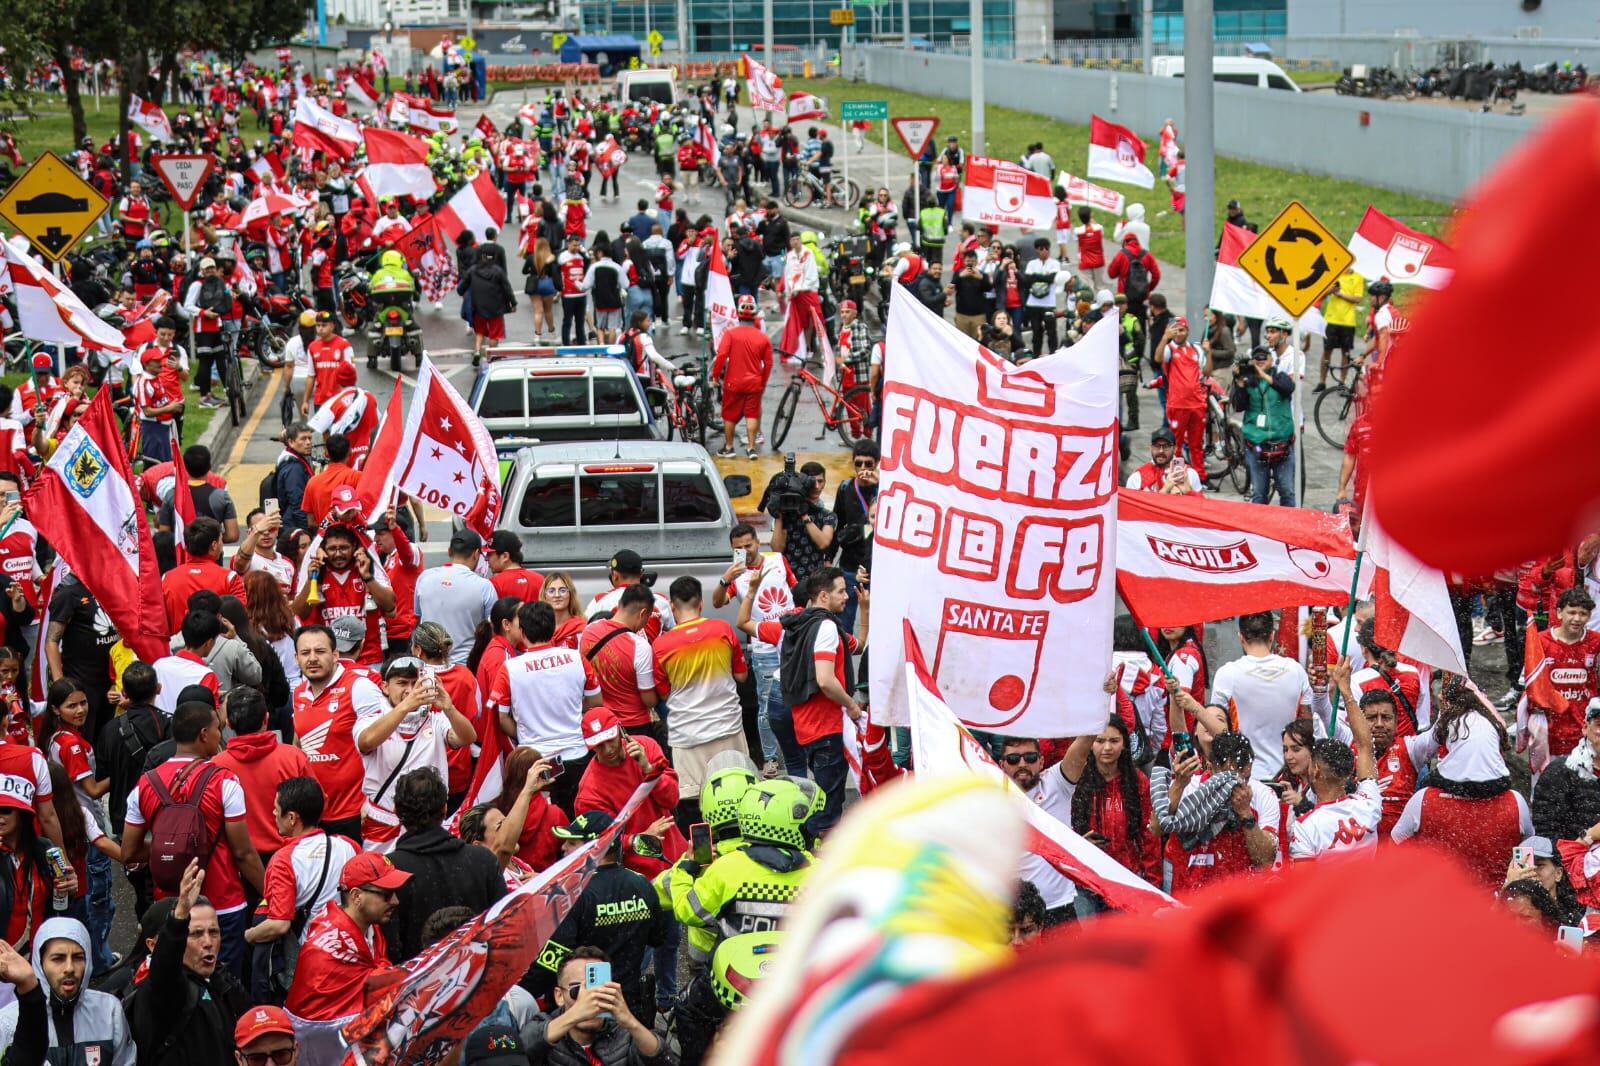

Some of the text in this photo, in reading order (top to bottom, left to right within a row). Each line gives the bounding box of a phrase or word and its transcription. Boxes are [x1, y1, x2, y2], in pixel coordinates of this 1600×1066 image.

[175, 161, 192, 169] CEDA
[180, 171, 188, 179] EL
[177, 181, 193, 189] PASO
[980, 212, 1035, 226] UN PUEBLO
[712, 302, 728, 317] DE
[416, 481, 451, 510] LOS
[1154, 540, 1251, 569] AGUILA
[947, 603, 1045, 636] SANTA FE
[525, 653, 574, 672] NECTAR
[596, 894, 649, 917] POLICÍA
